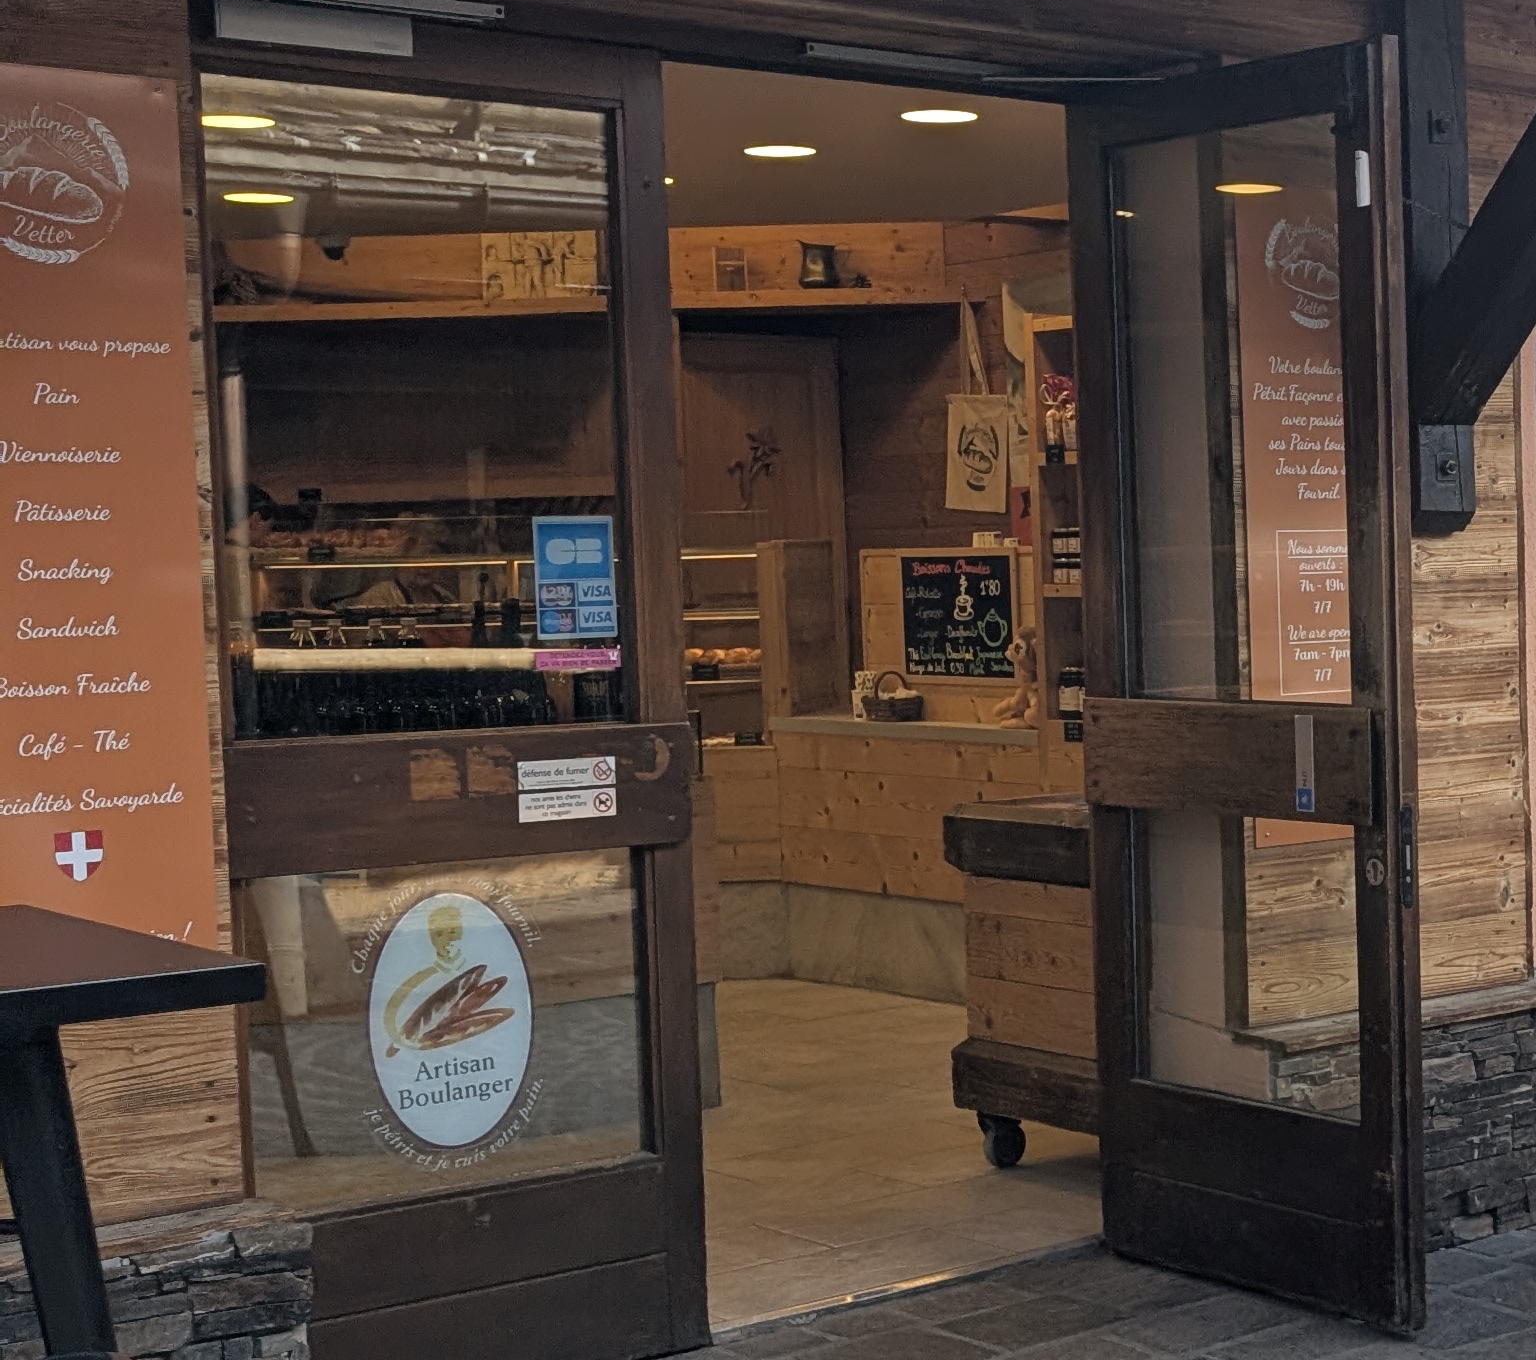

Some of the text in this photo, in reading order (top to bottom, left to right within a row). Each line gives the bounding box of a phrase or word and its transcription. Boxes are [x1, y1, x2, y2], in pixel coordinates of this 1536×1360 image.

[13, 214, 75, 243] Vetter
[58, 338, 98, 352] vous
[103, 340, 171, 358] propose
[1268, 356, 1342, 375] Votre boulan
[33, 382, 81, 405] Pain
[1289, 384, 1334, 406] Façonne
[1281, 414, 1344, 431] avec passio
[1268, 440, 1286, 450] ses
[1289, 433, 1321, 451] Pains
[0, 441, 121, 464] Viennoiserie
[1275, 457, 1307, 476] Jours
[1310, 458, 1338, 476] dans
[1298, 482, 1340, 500] Fournil.
[15, 499, 112, 523] Pâtisserie
[1288, 539, 1313, 555] Nous
[17, 558, 114, 584] Snacking
[1299, 558, 1336, 571] ouverts
[582, 585, 612, 598] VISA
[1300, 579, 1315, 592] 7h
[1325, 578, 1345, 592] 19h
[1313, 600, 1332, 614] 7/7
[582, 611, 613, 624] VISA
[16, 615, 119, 640] Sandwich
[1288, 624, 1306, 640] We
[1309, 629, 1327, 639] are
[1293, 648, 1320, 660] 7am
[77, 671, 151, 697] Fraîche
[1313, 668, 1332, 682] 7/7
[19, 732, 66, 761] Café
[94, 729, 131, 753] Thé
[521, 767, 589, 778] défense de fumer
[79, 783, 184, 812] Savoyarde
[414, 1055, 496, 1082] Artisan
[399, 1076, 514, 1111] Boulanger
